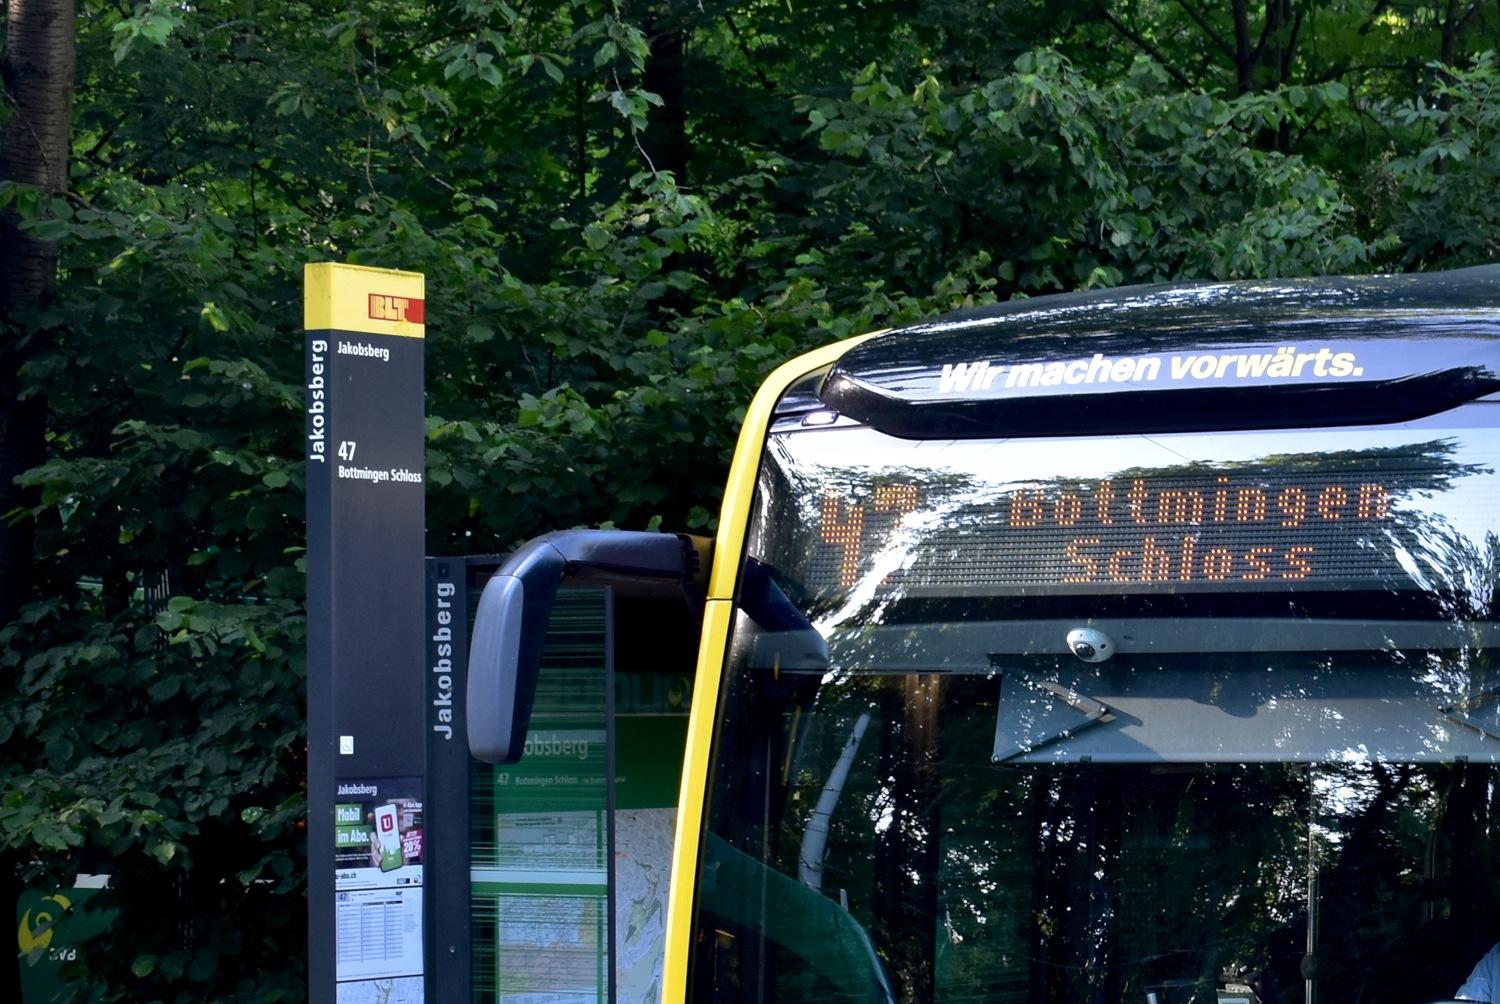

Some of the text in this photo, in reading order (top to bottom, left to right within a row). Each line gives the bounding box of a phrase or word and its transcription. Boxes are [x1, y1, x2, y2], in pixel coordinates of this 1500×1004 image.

[370, 294, 409, 321] BLT
[337, 341, 390, 362] Jakobsberg
[939, 346, 1365, 393] Wir machen vorwärts.
[308, 340, 328, 462] Jakobsberg
[338, 441, 356, 461] 47
[338, 465, 422, 483] Bottmingen Schloss
[1063, 535, 1313, 582] Schloss
[433, 582, 455, 740] Jakobsberg
[523, 734, 589, 760] obsberg
[337, 784, 378, 797] Jakobsberg
[496, 773, 510, 786] 47
[337, 829, 369, 843] im Abo.
